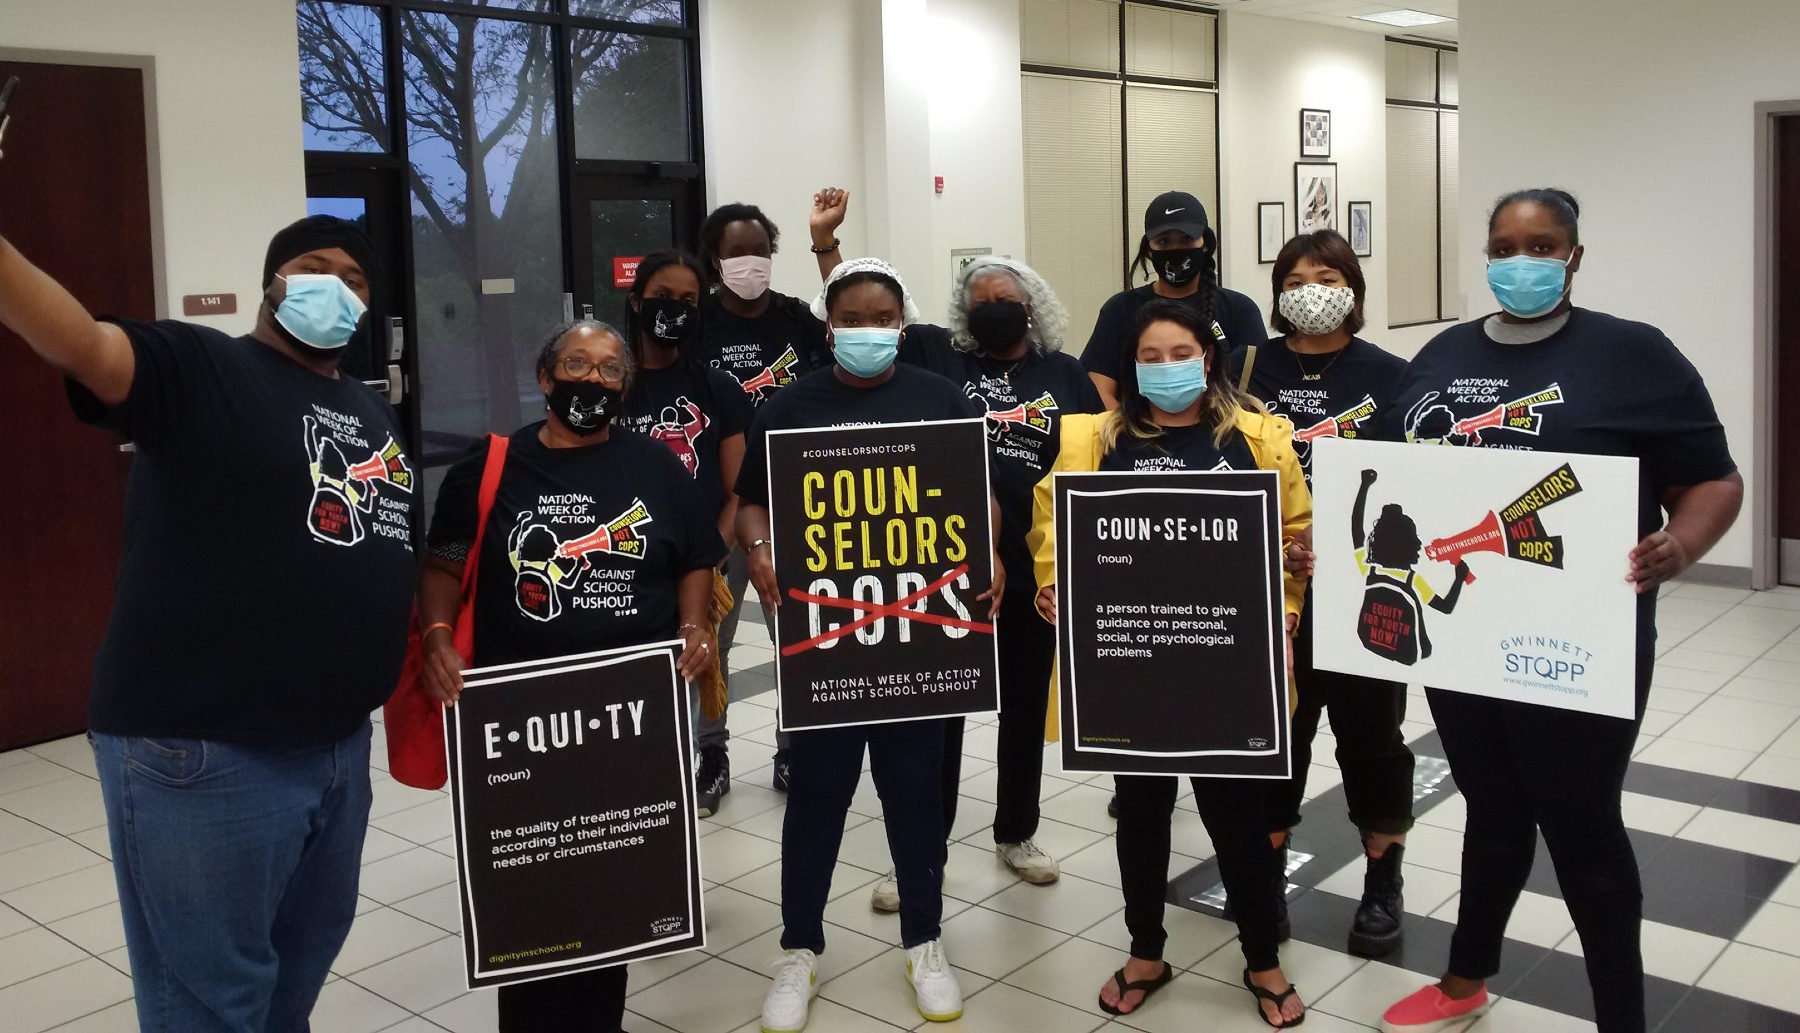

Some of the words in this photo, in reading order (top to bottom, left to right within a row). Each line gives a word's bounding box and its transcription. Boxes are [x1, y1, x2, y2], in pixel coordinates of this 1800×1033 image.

[722, 344, 762, 354] NATIONAL
[722, 353, 744, 362] WEEK
[733, 360, 762, 368] ACTION
[980, 381, 1001, 394] WEEK
[1002, 386, 1012, 394] OF
[1447, 386, 1479, 394] WEEK
[1480, 386, 1499, 394] OF
[1452, 378, 1510, 388] NATIONAL
[987, 391, 1018, 402] ACTION
[1279, 395, 1305, 406] WEEK
[1280, 389, 1329, 399] NATIONAL
[1455, 395, 1500, 404] ACTION
[1507, 392, 1558, 411] COUNSELORS
[312, 404, 363, 427] NATIONAL
[1290, 404, 1326, 416] ACTION
[1337, 404, 1375, 424] COUNSELORS
[316, 414, 343, 431] WEEK
[344, 425, 358, 435] OF
[1510, 417, 1532, 428] COPS
[333, 431, 369, 448] ACTION
[1008, 433, 1042, 449] AGAINST
[803, 444, 916, 458] #COUNSELORSNOTCOPS
[996, 447, 1038, 462] PUSHOUT
[1134, 456, 1186, 468] NATIONAL
[393, 472, 408, 485] COPS
[538, 494, 596, 505] NATIONAL
[803, 466, 942, 520] COUN-
[1503, 469, 1575, 523] COUNSELORS
[379, 497, 409, 512] AGAINST
[538, 506, 570, 515] WEEK
[572, 504, 588, 515] OF
[378, 509, 409, 528] SCHOOL
[551, 515, 596, 524] ACTION
[609, 506, 647, 532] COUNSELORS
[1510, 517, 1537, 540] NOT
[618, 540, 639, 553] COPS
[805, 514, 967, 572] SELORS
[1437, 529, 1501, 555] DIGNITYINSCHOOLS.ORG
[1097, 554, 1133, 565] (noun)
[1519, 541, 1554, 563] COPS
[590, 569, 636, 580] AGAINST
[583, 582, 633, 593] SCHOOL
[573, 596, 634, 608] PUSHOUT
[808, 569, 972, 649] COPS
[1096, 605, 1104, 613] a
[1107, 605, 1148, 618] person
[1150, 604, 1193, 615] trained
[1196, 605, 1209, 615] to
[1212, 605, 1238, 618] give
[1372, 603, 1403, 620] EQUITY
[1096, 617, 1150, 630] guidance
[1154, 620, 1169, 629] on
[1172, 619, 1227, 632] personal,
[1364, 613, 1378, 626] FOR
[1382, 618, 1410, 636] YOUTH
[1096, 632, 1133, 644] social,
[1136, 634, 1149, 643] or
[1152, 634, 1234, 646] psychological
[1370, 626, 1398, 647] NOW!
[1097, 647, 1152, 658] problems
[1500, 636, 1593, 662] GWINNETT
[811, 677, 872, 691] NATIONAL
[878, 674, 911, 685] WEEK
[916, 672, 931, 682] OF
[936, 668, 981, 680] ACTION
[812, 690, 864, 703] AGAINST
[870, 686, 917, 698] SCHOOL
[922, 680, 978, 693] PUSHOUT
[1503, 677, 1589, 698] www.gwinnettstopp.org
[487, 768, 531, 786] (noun)
[490, 829, 512, 840] the
[516, 819, 560, 838] quality
[563, 816, 577, 828] of
[580, 807, 630, 824] treating
[634, 800, 677, 818] people
[492, 834, 556, 855] according
[560, 832, 574, 844] to
[577, 826, 607, 840] their
[609, 815, 670, 834] individual
[492, 854, 533, 869] needs
[536, 851, 550, 862] or
[553, 834, 645, 859] circumstances
[489, 940, 583, 964] dignityinschools.org
